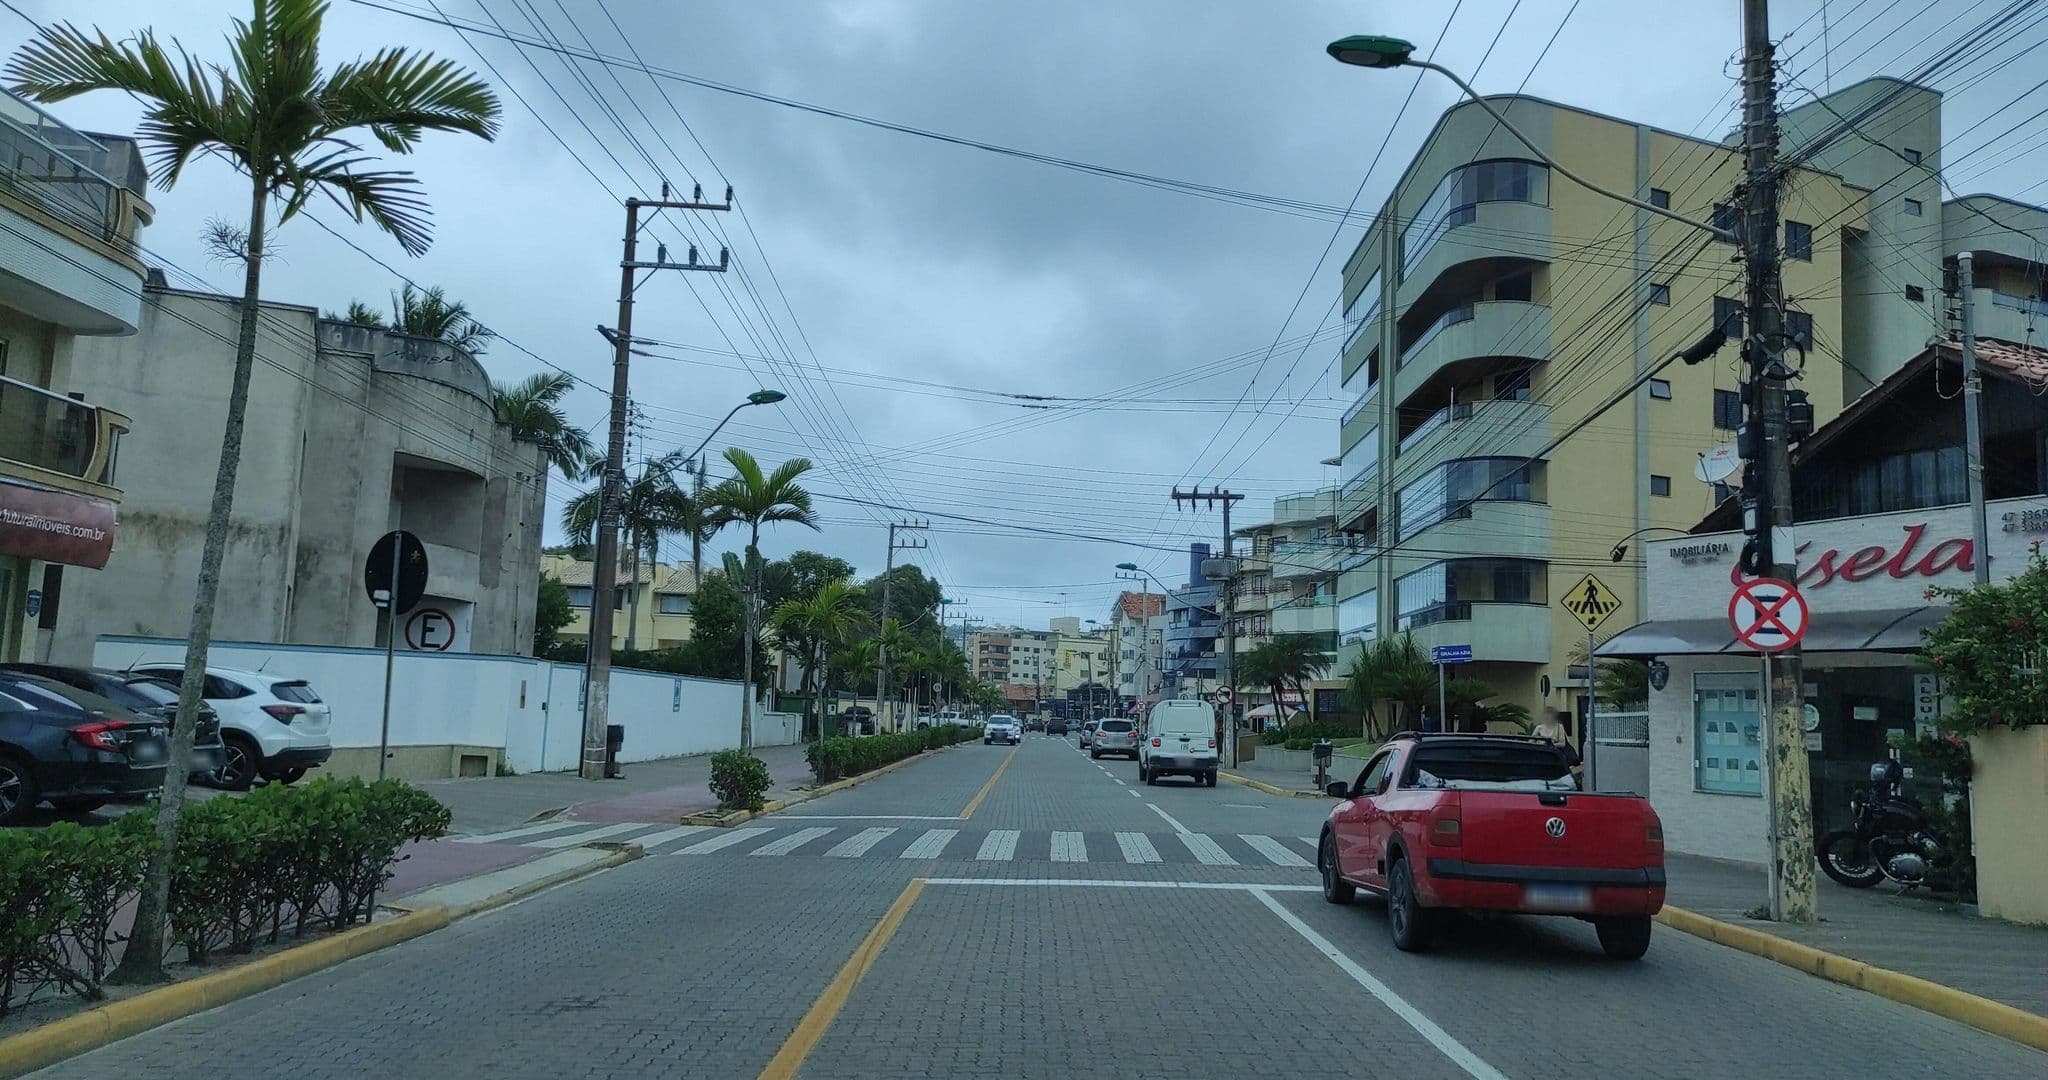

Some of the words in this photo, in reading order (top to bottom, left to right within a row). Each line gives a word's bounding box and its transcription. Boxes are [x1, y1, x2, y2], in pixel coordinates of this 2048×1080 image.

[0, 508, 105, 541] .futuraimoveis.com.br
[1670, 542, 1729, 558] IMOBILIÁRIA
[420, 614, 443, 649] E
